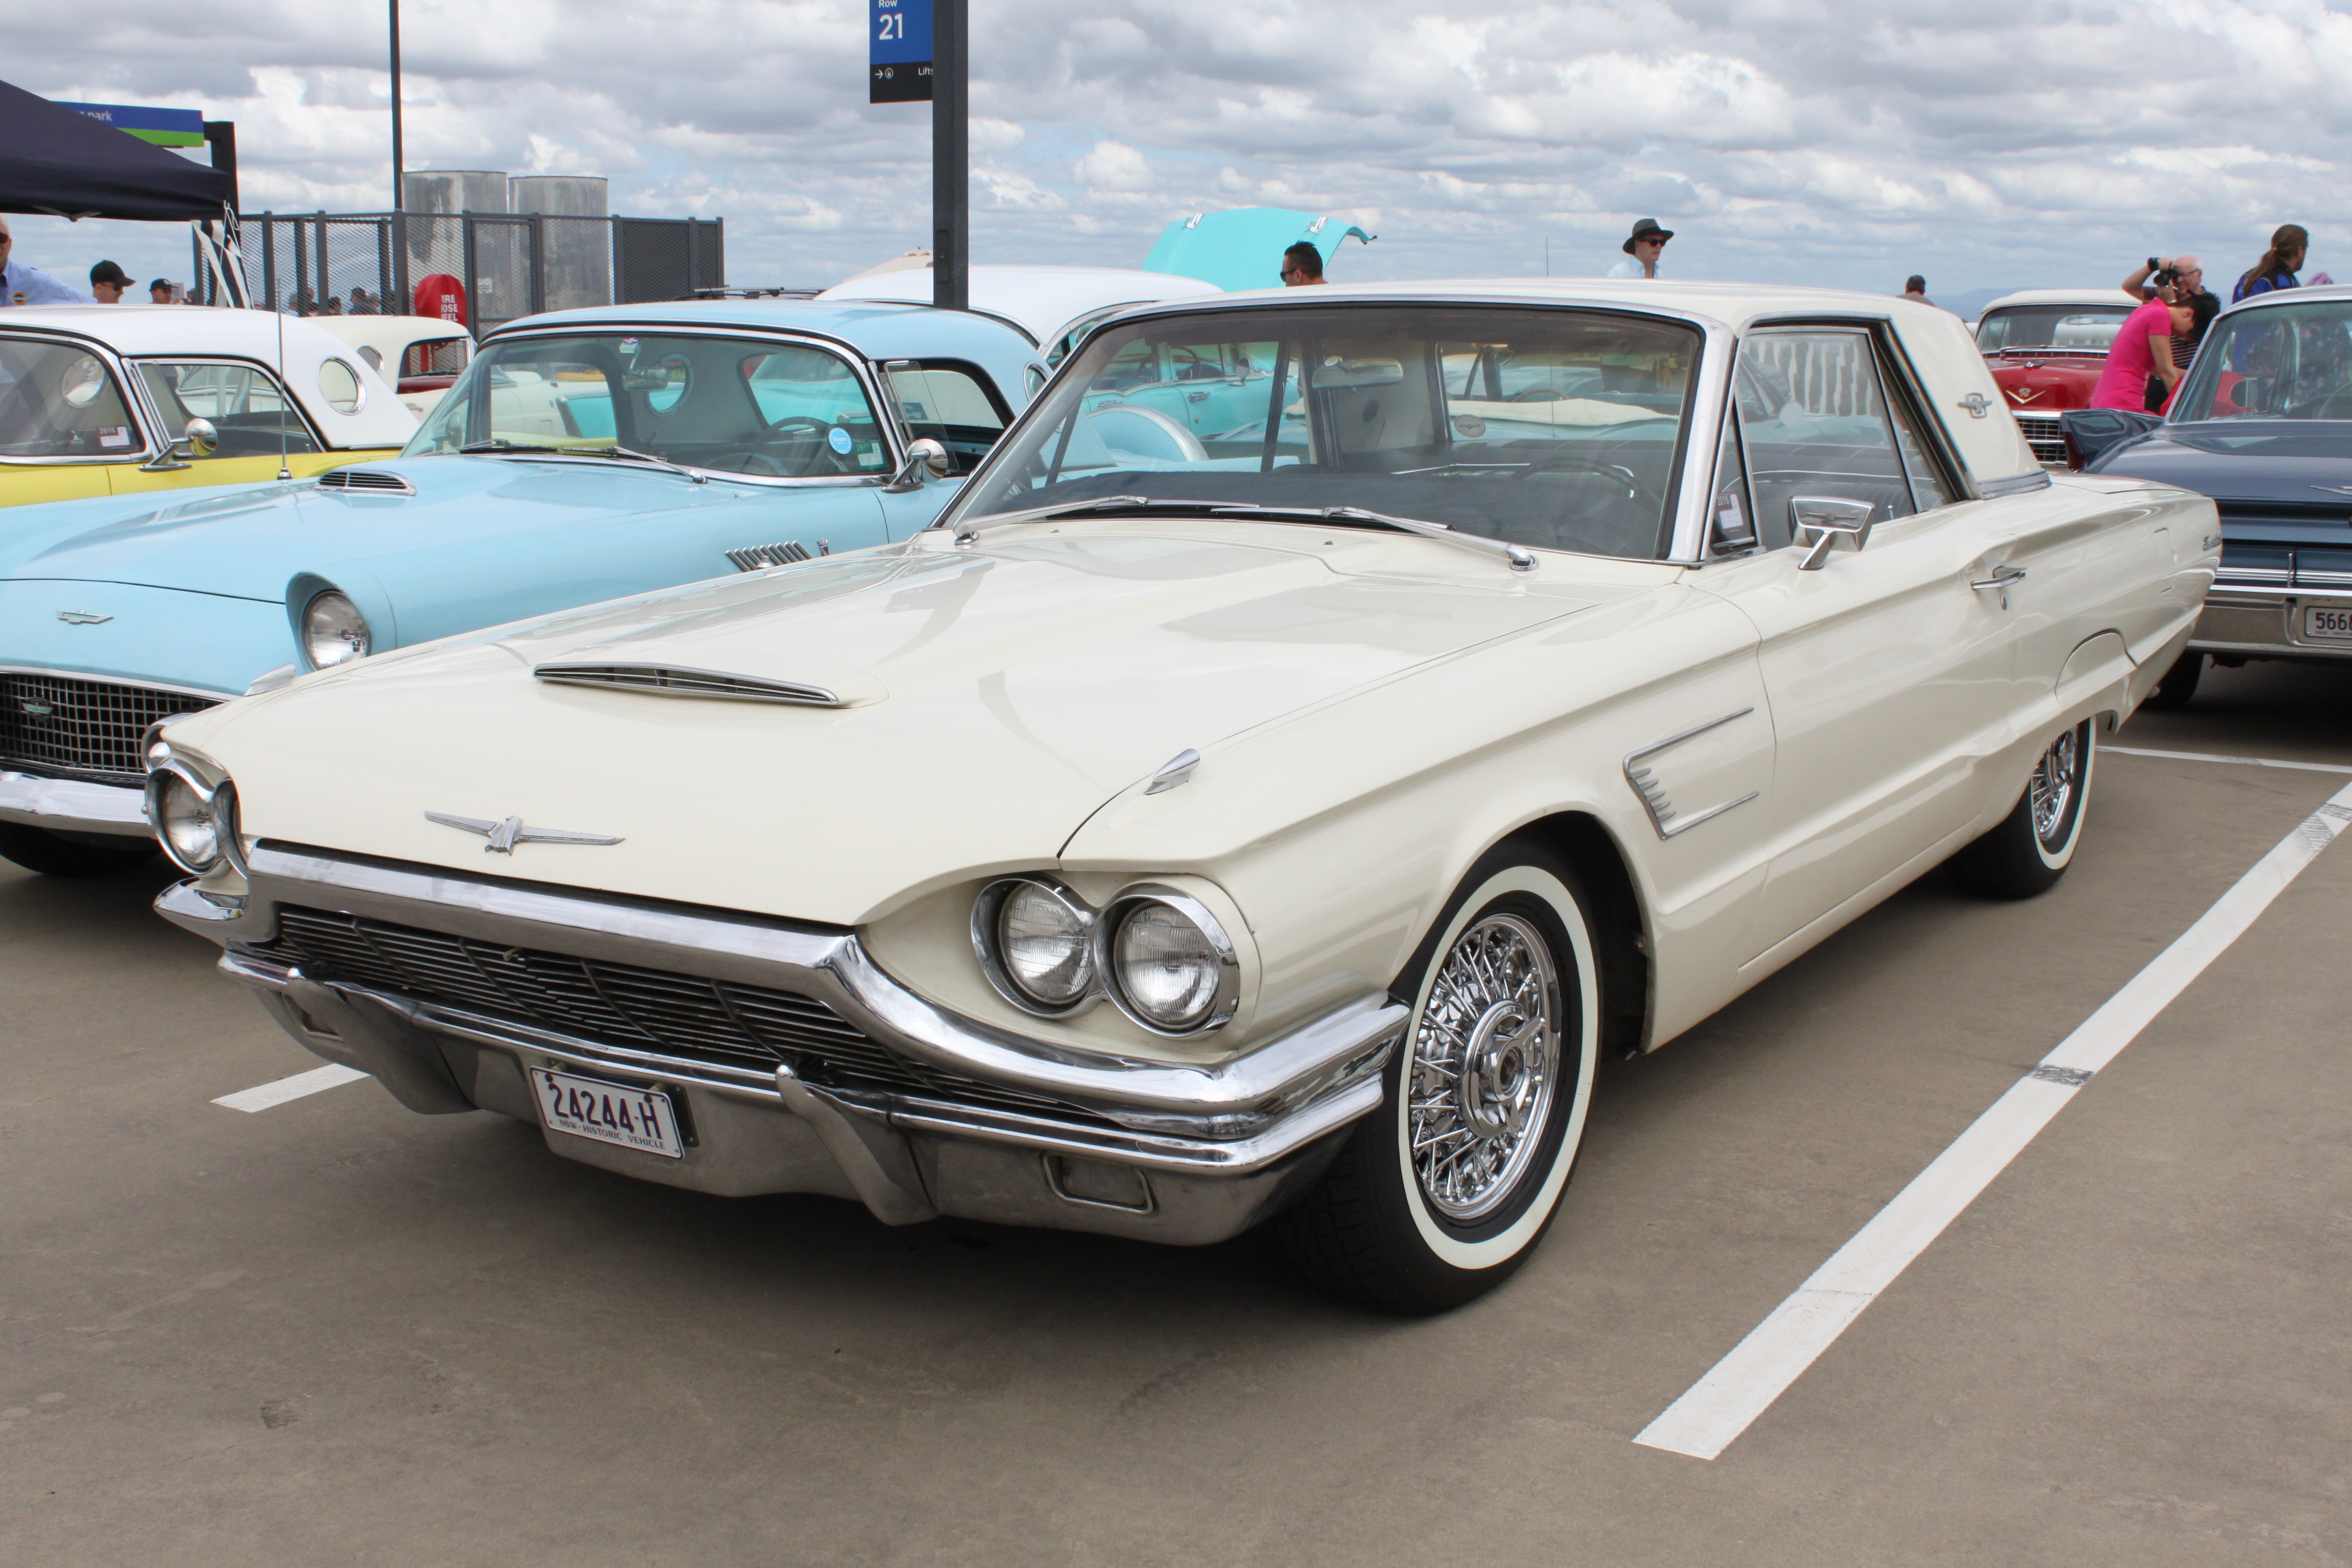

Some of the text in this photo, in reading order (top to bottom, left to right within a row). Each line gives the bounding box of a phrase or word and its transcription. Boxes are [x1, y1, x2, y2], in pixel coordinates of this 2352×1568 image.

[879, 13, 902, 40] 21
[559, 1119, 577, 1129] NSW
[582, 1125, 623, 1139] HISTORIC
[628, 1135, 666, 1149] VEHICLE
